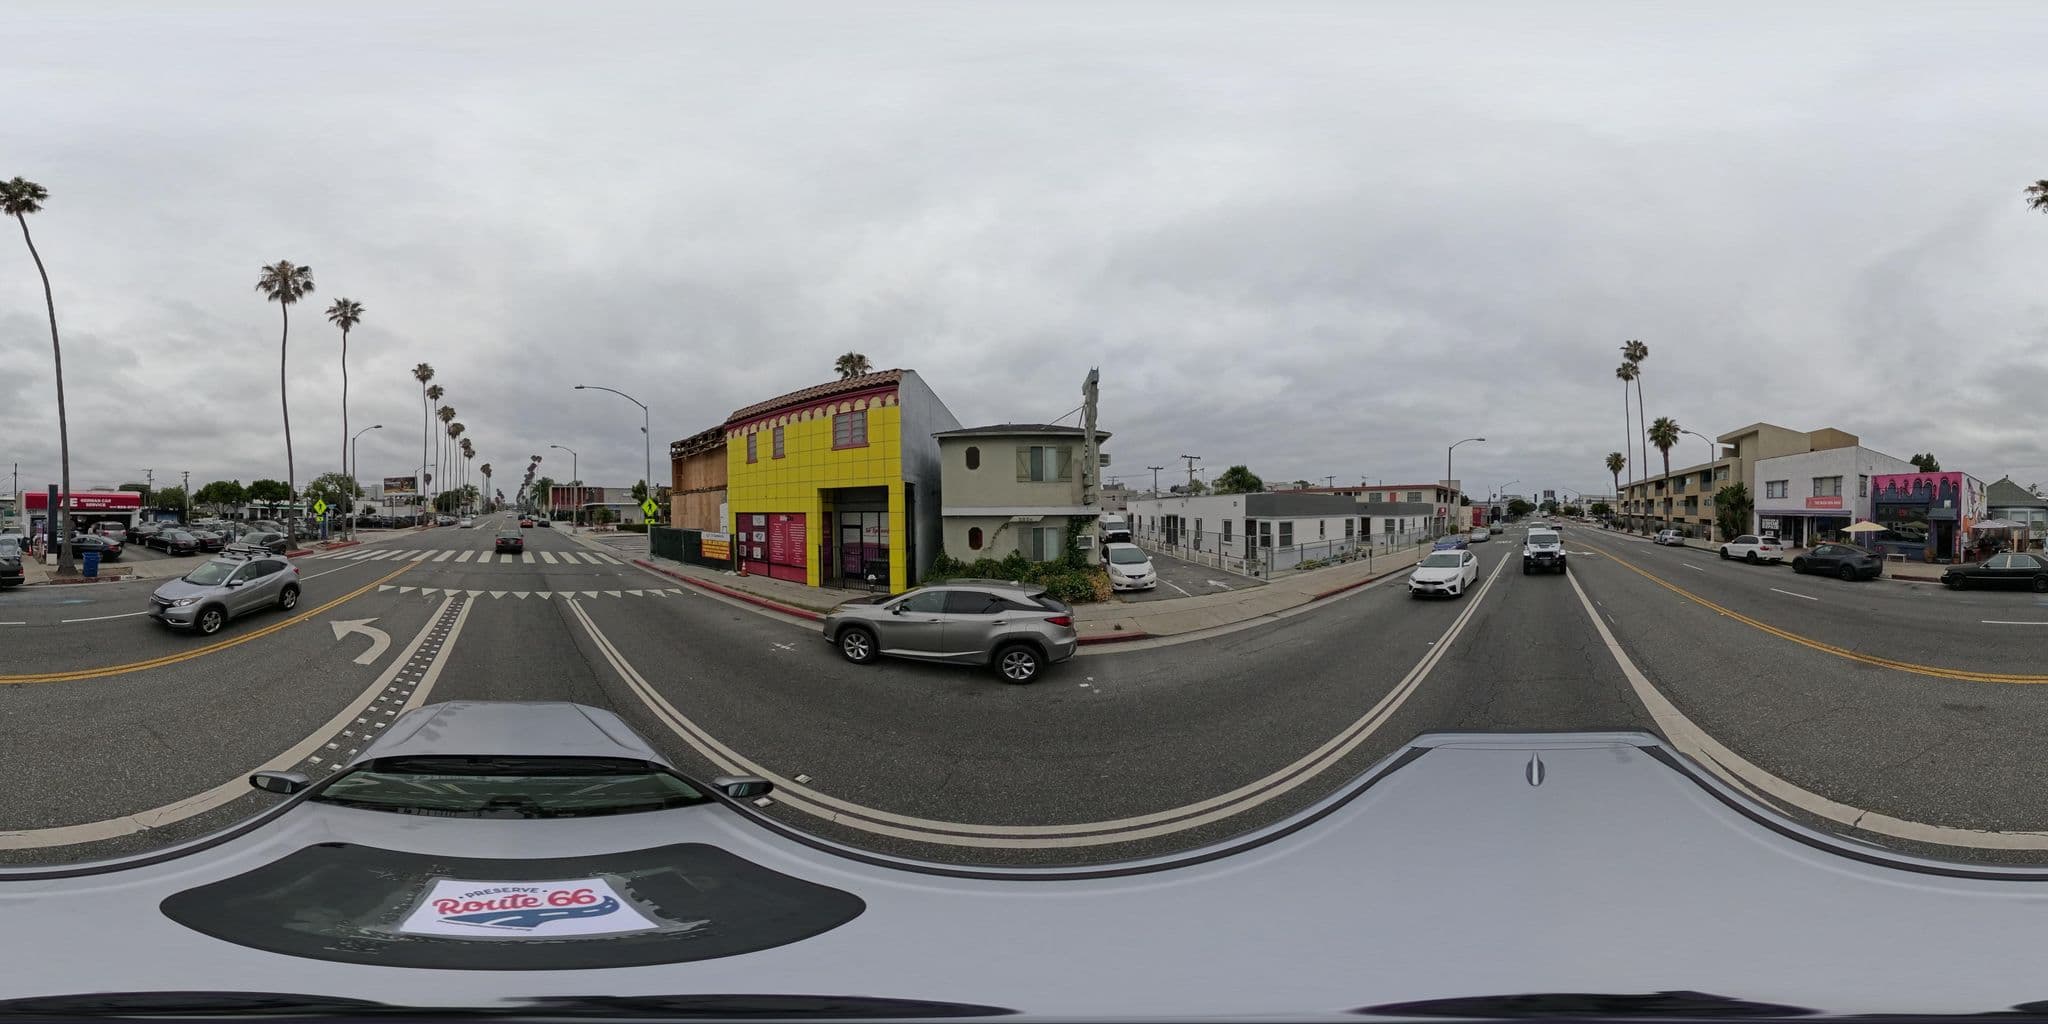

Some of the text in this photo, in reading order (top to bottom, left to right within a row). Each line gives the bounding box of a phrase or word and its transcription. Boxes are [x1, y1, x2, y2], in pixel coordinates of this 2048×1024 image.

[432, 888, 597, 914] Route 66
[465, 887, 538, 899] PRESERVE
